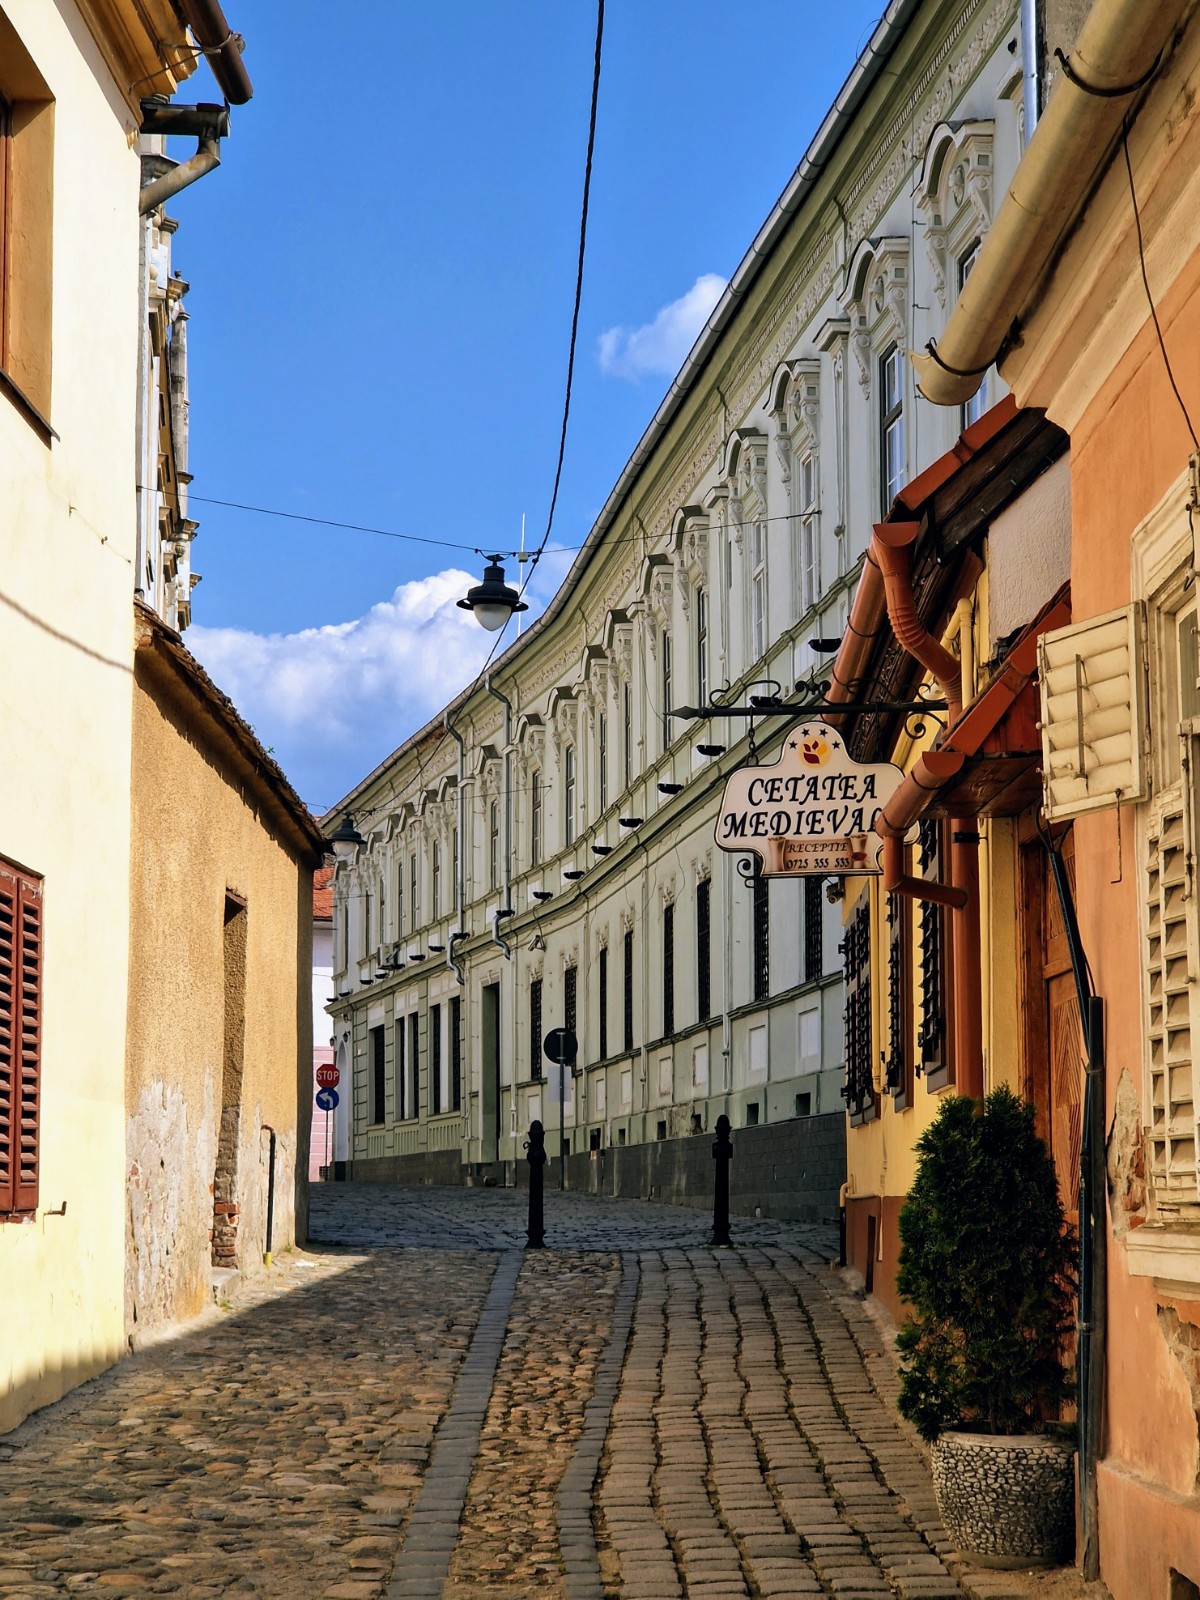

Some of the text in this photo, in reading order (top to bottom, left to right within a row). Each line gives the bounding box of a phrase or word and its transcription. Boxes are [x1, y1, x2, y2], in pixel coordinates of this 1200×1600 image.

[748, 773, 877, 806] CETATEA
[723, 805, 882, 838] MEDIEVAL
[787, 842, 848, 853] RECEPTIE
[786, 858, 809, 869] 0725
[813, 857, 829, 868] 355
[317, 1070, 339, 1081] STOP
